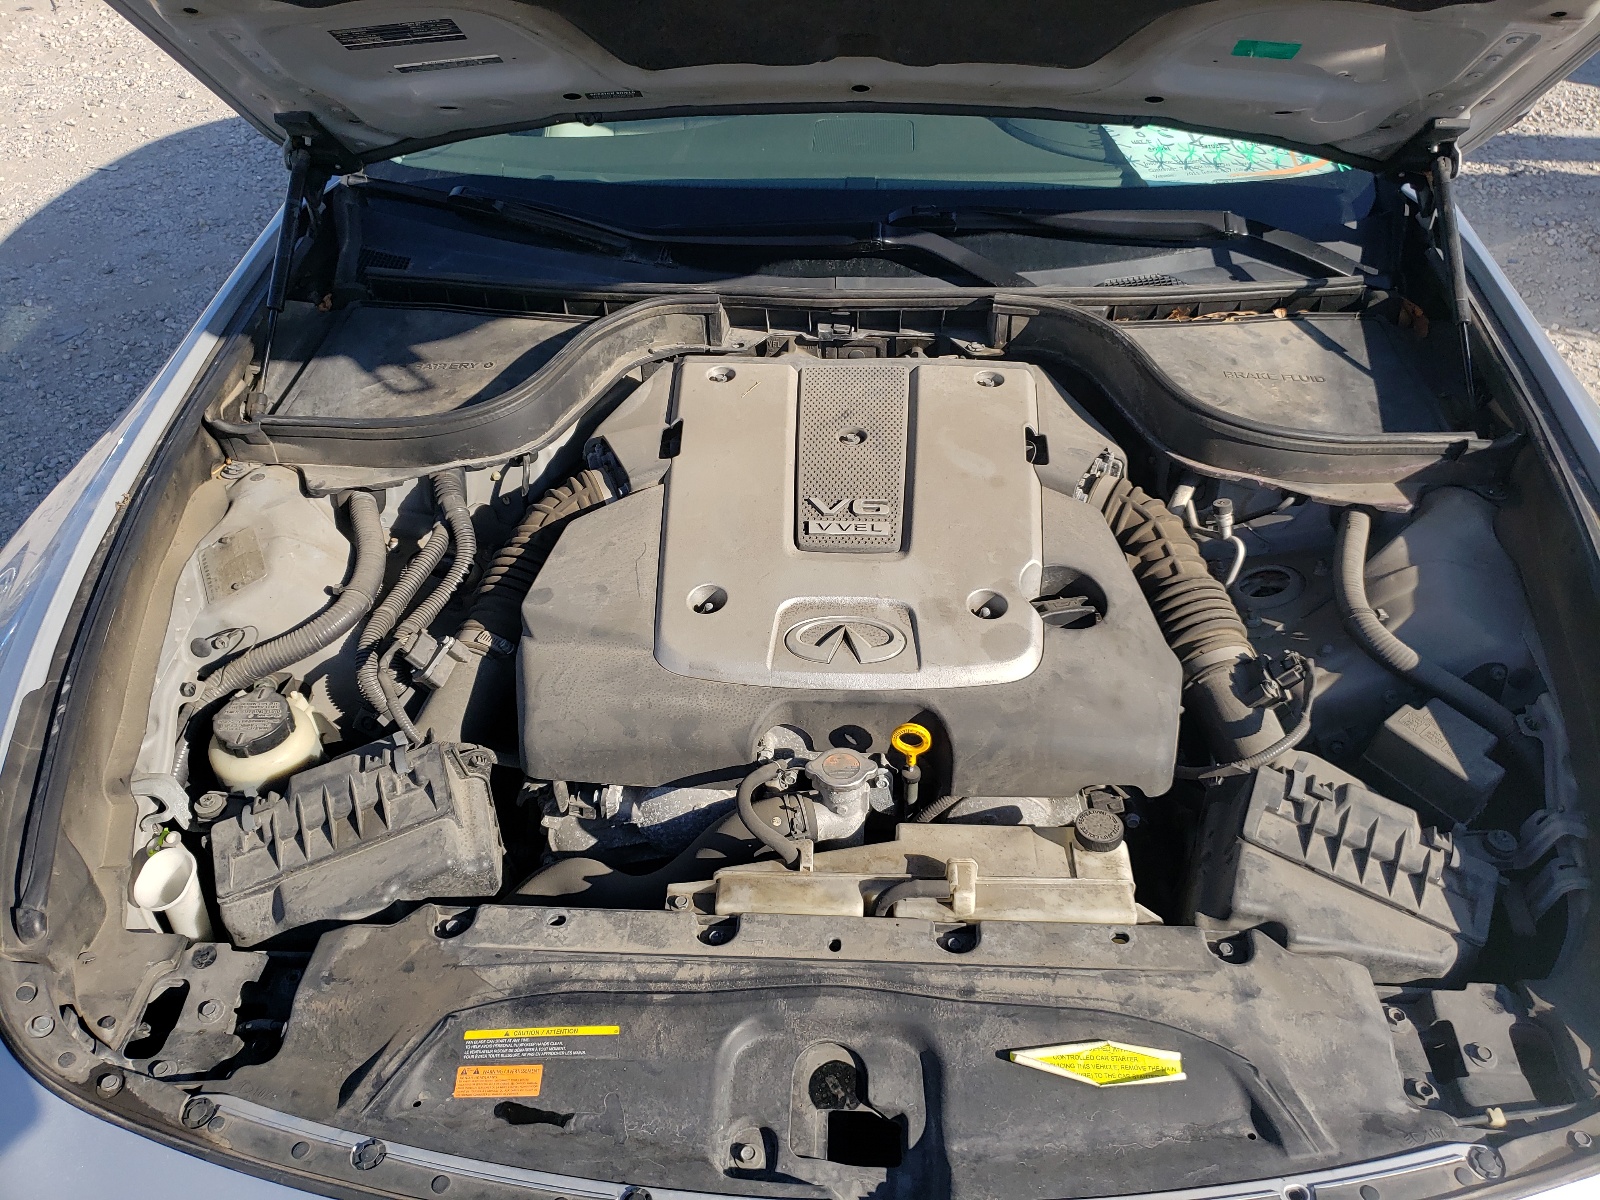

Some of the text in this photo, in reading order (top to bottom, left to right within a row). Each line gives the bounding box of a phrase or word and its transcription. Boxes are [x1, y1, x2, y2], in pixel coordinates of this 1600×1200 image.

[416, 362, 479, 370] BATTERY
[1223, 370, 1326, 383] BRAKE FLUID
[802, 496, 890, 518] V6
[816, 522, 883, 533] VVEL
